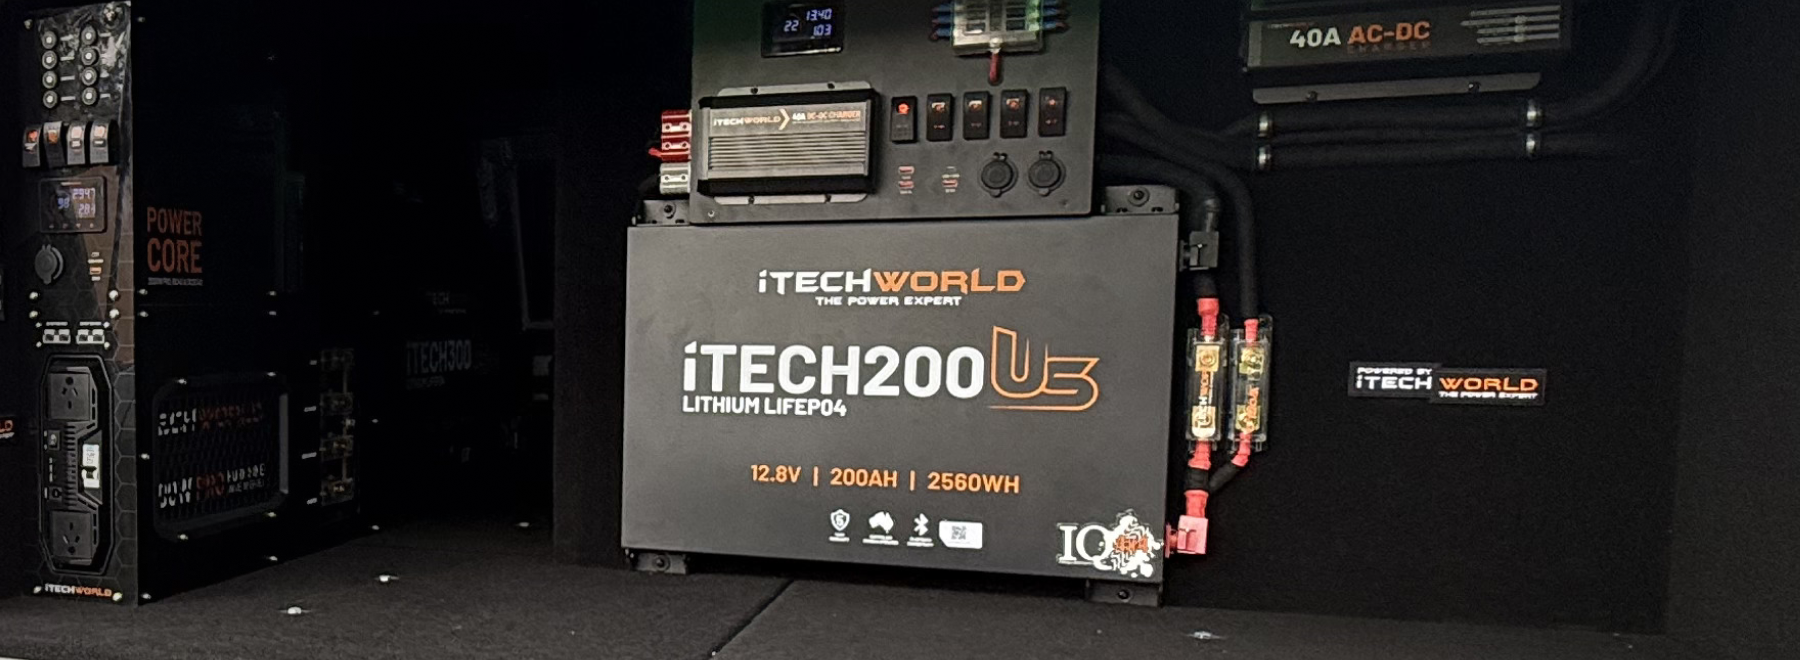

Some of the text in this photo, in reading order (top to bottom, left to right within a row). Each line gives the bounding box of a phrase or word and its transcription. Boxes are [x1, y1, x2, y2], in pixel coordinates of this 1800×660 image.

[783, 19, 800, 32] 22
[1289, 21, 1432, 49] 40A AC-DC
[147, 206, 204, 237] POWER
[147, 237, 204, 274] CORE
[758, 267, 1026, 297] iTECHWORLD
[814, 296, 963, 307] THE POWER EXPERT
[683, 340, 985, 399] iTECH200
[1357, 367, 1433, 376] POWERED BY
[1356, 376, 1540, 392] iTECH WORLD
[1460, 391, 1496, 399] POWER
[1499, 392, 1539, 400] EXPERT
[682, 395, 760, 415] LITHIUM
[751, 464, 802, 484] 12.8V
[830, 467, 898, 488] 200AH
[927, 471, 1020, 494] 2560WH
